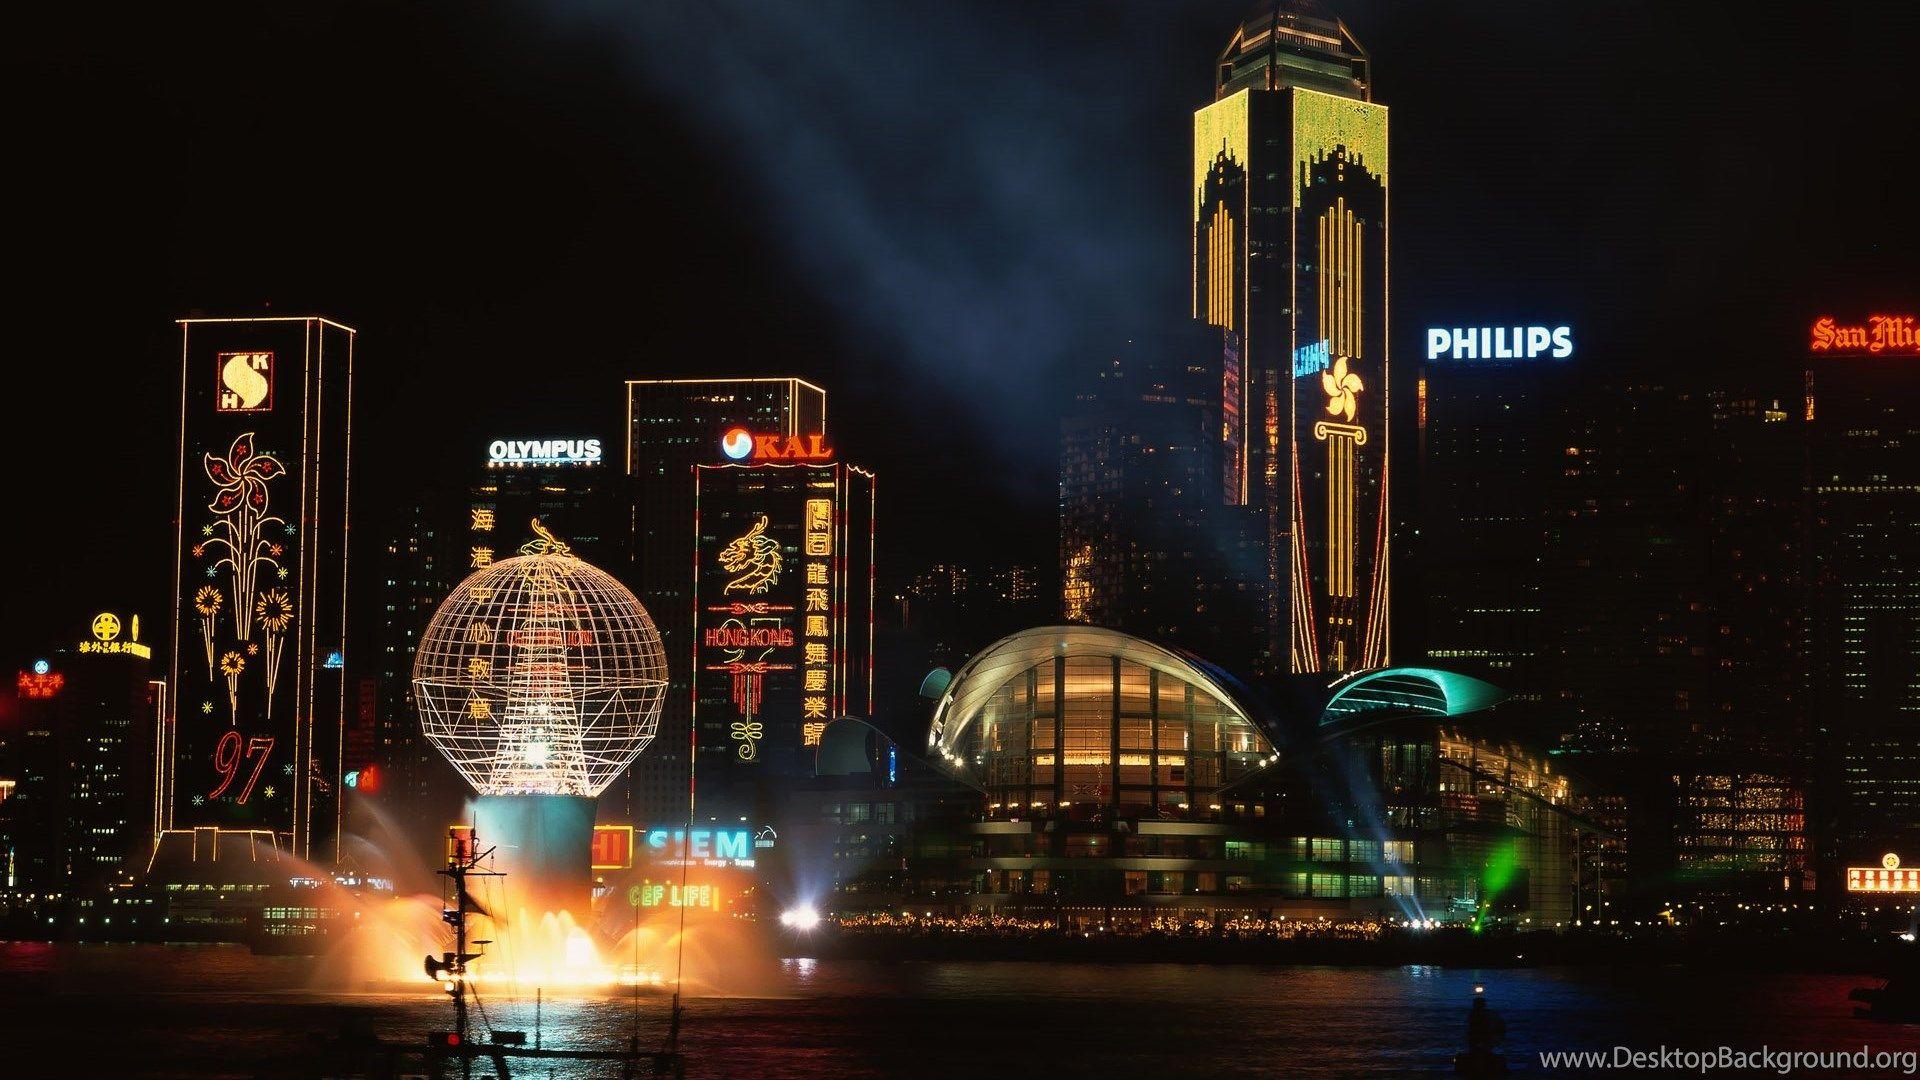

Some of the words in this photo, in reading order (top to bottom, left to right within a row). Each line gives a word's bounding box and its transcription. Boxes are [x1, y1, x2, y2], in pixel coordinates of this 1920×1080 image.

[1428, 326, 1573, 360] PHILIPS
[1812, 318, 1868, 350] San
[489, 439, 602, 460] OLYMPUS
[754, 435, 833, 459] KAL
[706, 628, 749, 648] HONG
[750, 628, 795, 648] KONG
[208, 731, 275, 805] 97
[671, 885, 711, 907] LIFE
